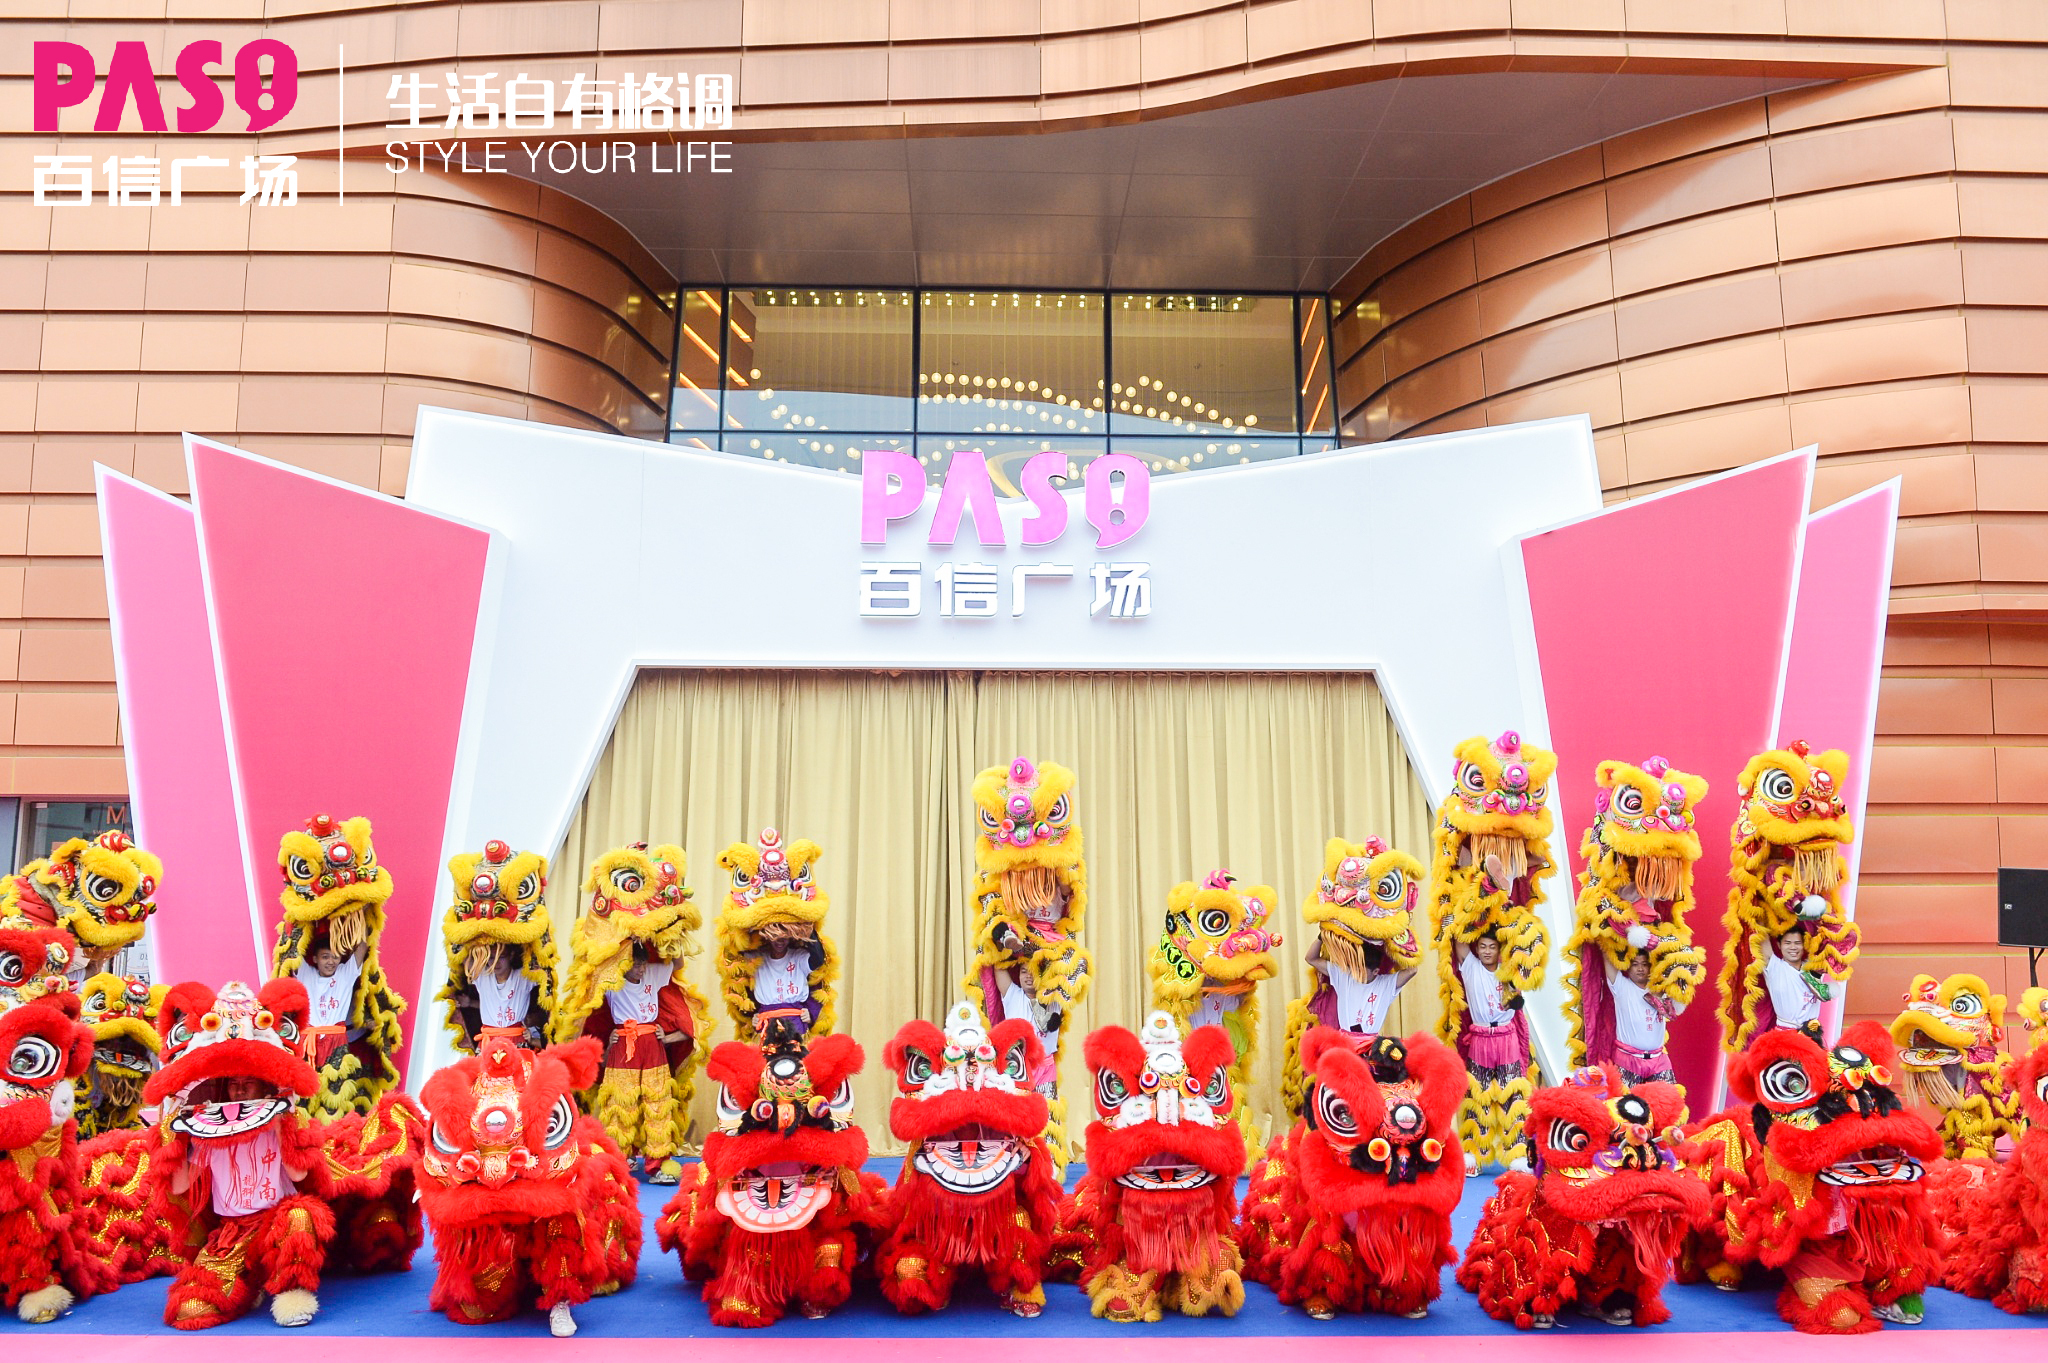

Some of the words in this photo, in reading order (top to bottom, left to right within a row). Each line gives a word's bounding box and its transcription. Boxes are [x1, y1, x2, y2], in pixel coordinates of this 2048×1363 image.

[859, 561, 1152, 618] 百信广场
[786, 961, 799, 995] 中南
[259, 1148, 277, 1202] 中南
